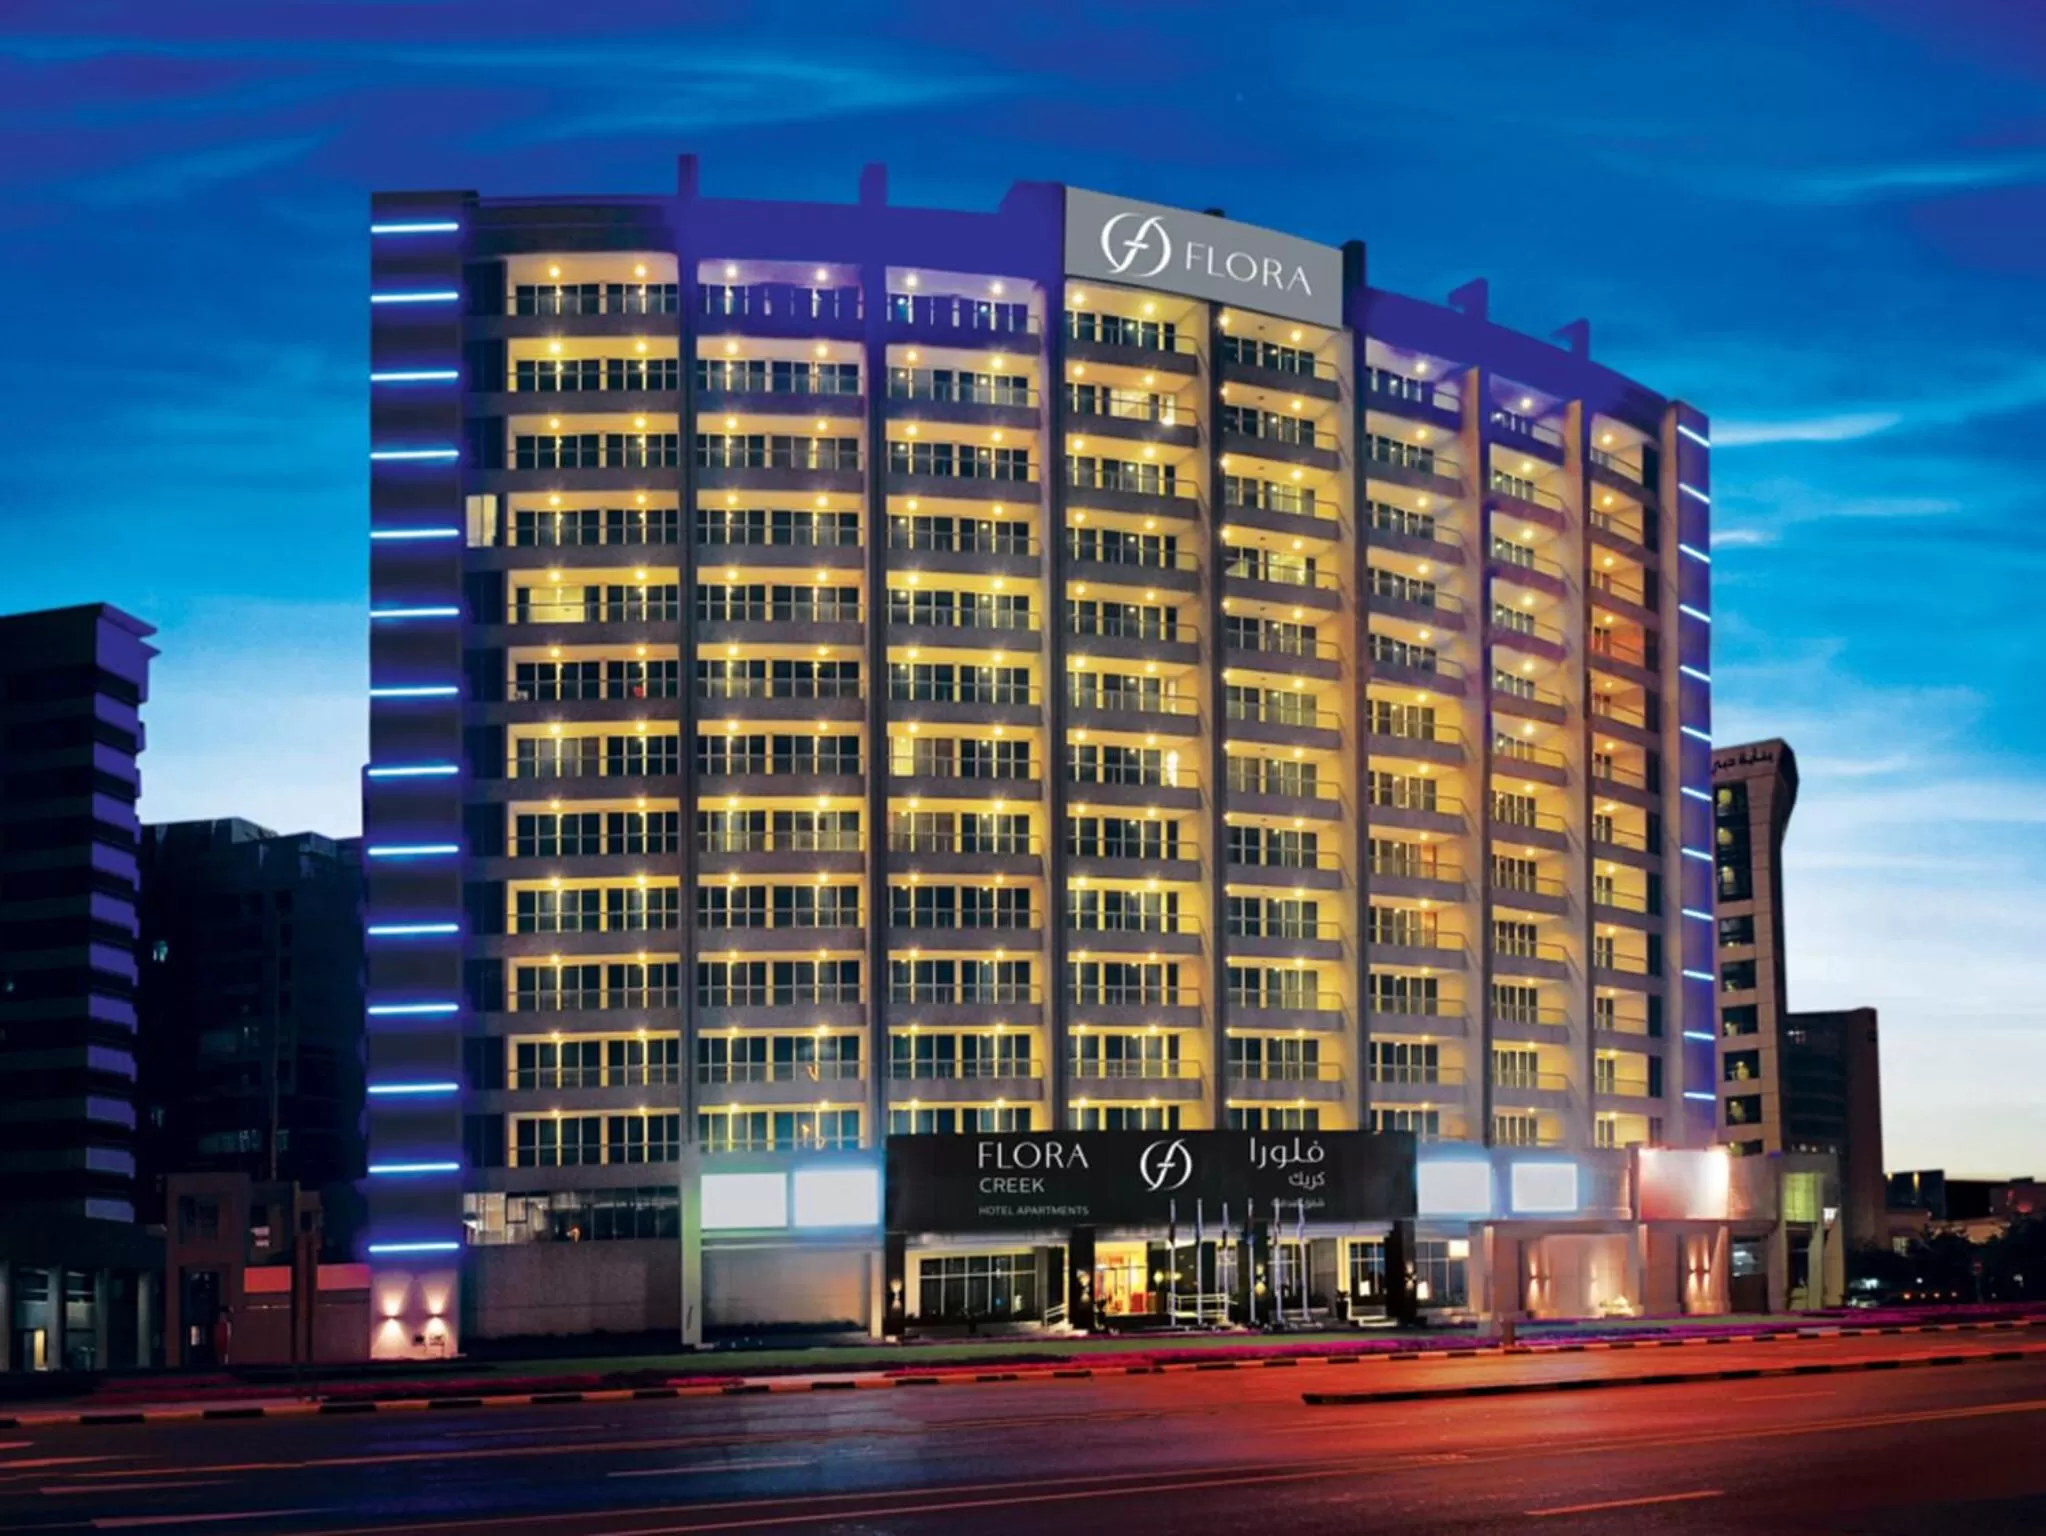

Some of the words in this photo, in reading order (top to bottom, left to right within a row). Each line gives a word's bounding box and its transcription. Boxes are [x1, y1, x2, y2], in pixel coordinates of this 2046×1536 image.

[1185, 241, 1313, 297] FLORA
[978, 1141, 1089, 1169] FLORA
[1250, 1136, 1325, 1169] فلورا
[979, 1177, 1045, 1194] CREEK
[1287, 1170, 1326, 1190] كريك
[978, 1205, 1015, 1216] HOTEL
[1016, 1205, 1090, 1216] APARTMENTS
